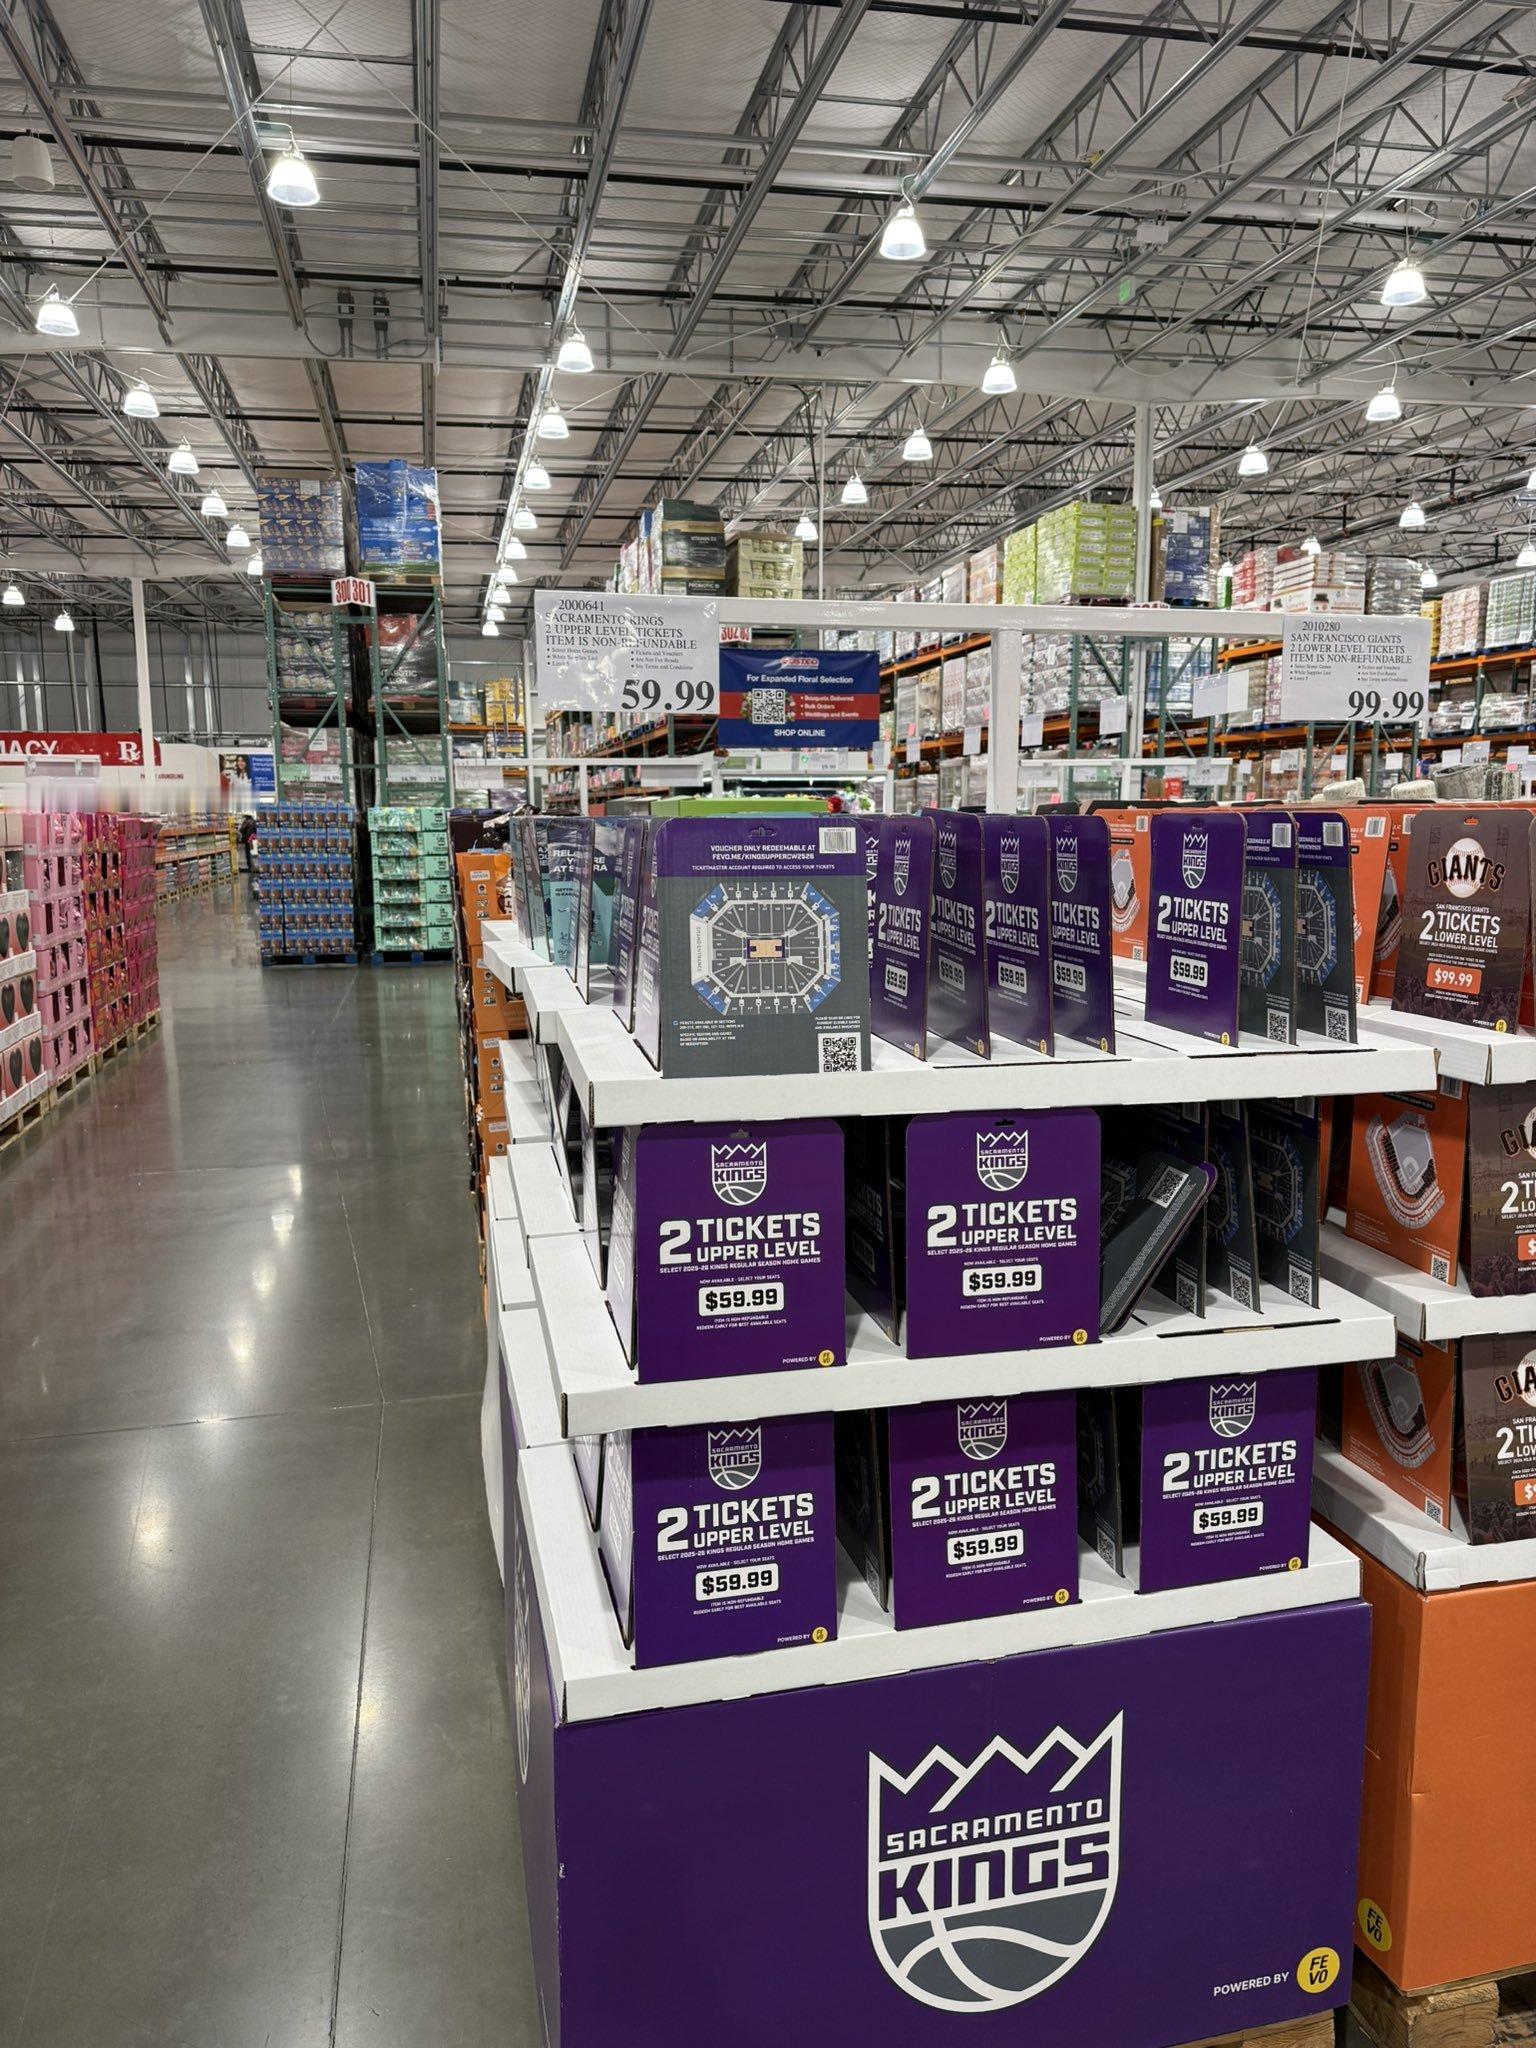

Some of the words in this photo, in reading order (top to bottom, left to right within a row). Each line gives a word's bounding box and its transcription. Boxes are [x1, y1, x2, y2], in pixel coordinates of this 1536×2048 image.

[352, 581, 371, 605] 301
[558, 599, 604, 612] 2000641
[546, 625, 551, 634] 2
[555, 625, 591, 636] UPPER
[636, 628, 683, 638] TICKETS
[629, 616, 664, 626] KINGS
[1302, 621, 1340, 631] 2010280
[546, 635, 575, 646] ITEM
[578, 637, 588, 647] IS
[1290, 644, 1295, 652] 2
[1298, 644, 1332, 652] LOWER
[1335, 645, 1364, 653] LEVEL
[1368, 646, 1405, 654] TICKETS
[1291, 633, 1310, 642] SAN
[1313, 634, 1365, 643] FRANCISCO
[1368, 635, 1402, 644] GIANTS
[1290, 654, 1314, 662] ITEM
[1328, 654, 1412, 664] NON-REFUNDABLE
[761, 675, 796, 683] Expanded
[820, 676, 853, 684] Selection
[621, 679, 715, 711] 59.99
[1348, 690, 1424, 718] 99.99
[1426, 855, 1506, 892] GIANTS
[936, 894, 975, 930] TICKETS
[985, 899, 996, 939] 2
[996, 900, 1039, 931] TICKETS
[1052, 900, 1100, 930] TICKETS
[1157, 895, 1173, 932] 2
[1173, 896, 1229, 925] TICKETS
[1446, 904, 1471, 912] FRANCISCO
[878, 902, 887, 941] 2
[888, 904, 922, 933] TICKETS
[1172, 920, 1200, 939] UPPER
[1200, 927, 1227, 943] LEVEL
[1420, 910, 1435, 940] 2
[1438, 911, 1500, 935] TICKETS
[887, 929, 902, 946] UPPER
[903, 933, 920, 951] LEVEL
[936, 922, 955, 940] UPPER
[957, 928, 976, 948] LEVEL
[996, 926, 1017, 945] UPPER
[1018, 930, 1039, 949] LEVEL
[1053, 925, 1076, 943] UPPER
[1077, 929, 1100, 948] LEVEL
[1435, 931, 1466, 944] LOWER
[1469, 935, 1498, 948] LEVEL
[1000, 965, 1025, 987] $59.99
[1055, 963, 1084, 986] $59.99
[1173, 959, 1205, 981] $59.99
[1434, 967, 1473, 988] $99.99
[979, 1155, 1026, 1169] KINGS
[714, 1168, 765, 1182] KINGS
[927, 1205, 957, 1248] 2
[962, 1198, 1077, 1227] TICKETS
[659, 1220, 692, 1265] 2
[696, 1212, 820, 1243] TICKETS
[962, 1228, 1019, 1245] UPPER
[1024, 1225, 1076, 1242] LEVEL
[697, 1244, 758, 1263] UPPER
[764, 1241, 820, 1258] LEVEL
[969, 1270, 1036, 1292] $59.99
[705, 1288, 777, 1312] $59.99
[1211, 1404, 1254, 1418] KINGS
[959, 1423, 1006, 1440] KINGS
[710, 1451, 760, 1468] KINGS
[1163, 1452, 1190, 1492] 2
[1194, 1440, 1297, 1471] TICKETS
[1194, 1470, 1244, 1489] UPPER
[1249, 1464, 1295, 1482] LEVEL
[911, 1476, 940, 1520] 2
[945, 1463, 1056, 1497] TICKETS
[945, 1495, 1000, 1515] UPPER
[1005, 1489, 1056, 1508] LEVEL
[657, 1507, 688, 1553] 2
[693, 1492, 814, 1529] TICKETS
[1198, 1507, 1258, 1531] $59.99
[693, 1526, 754, 1548] UPPER
[759, 1520, 814, 1540] LEVEL
[657, 1554, 679, 1562] SELECT
[680, 1551, 705, 1559] 2025-26
[706, 1548, 725, 1556] KINGS
[726, 1545, 751, 1553] REGULAR
[753, 1542, 775, 1550] SEASON
[777, 1539, 793, 1547] HOME
[953, 1535, 1018, 1560] $59.99
[702, 1570, 772, 1596] $59.99
[777, 1635, 803, 1643] POWERED
[885, 1798, 1103, 1854] SACRAMENTO
[878, 1829, 1109, 1921] KINGS
[1368, 1907, 1383, 1928] FE
[1366, 1919, 1382, 1942] VO
[1310, 1954, 1329, 1971] FE
[1213, 1976, 1271, 1996] POWERED
[1273, 1972, 1289, 1984] BY
[1309, 1969, 1328, 1985] VO
